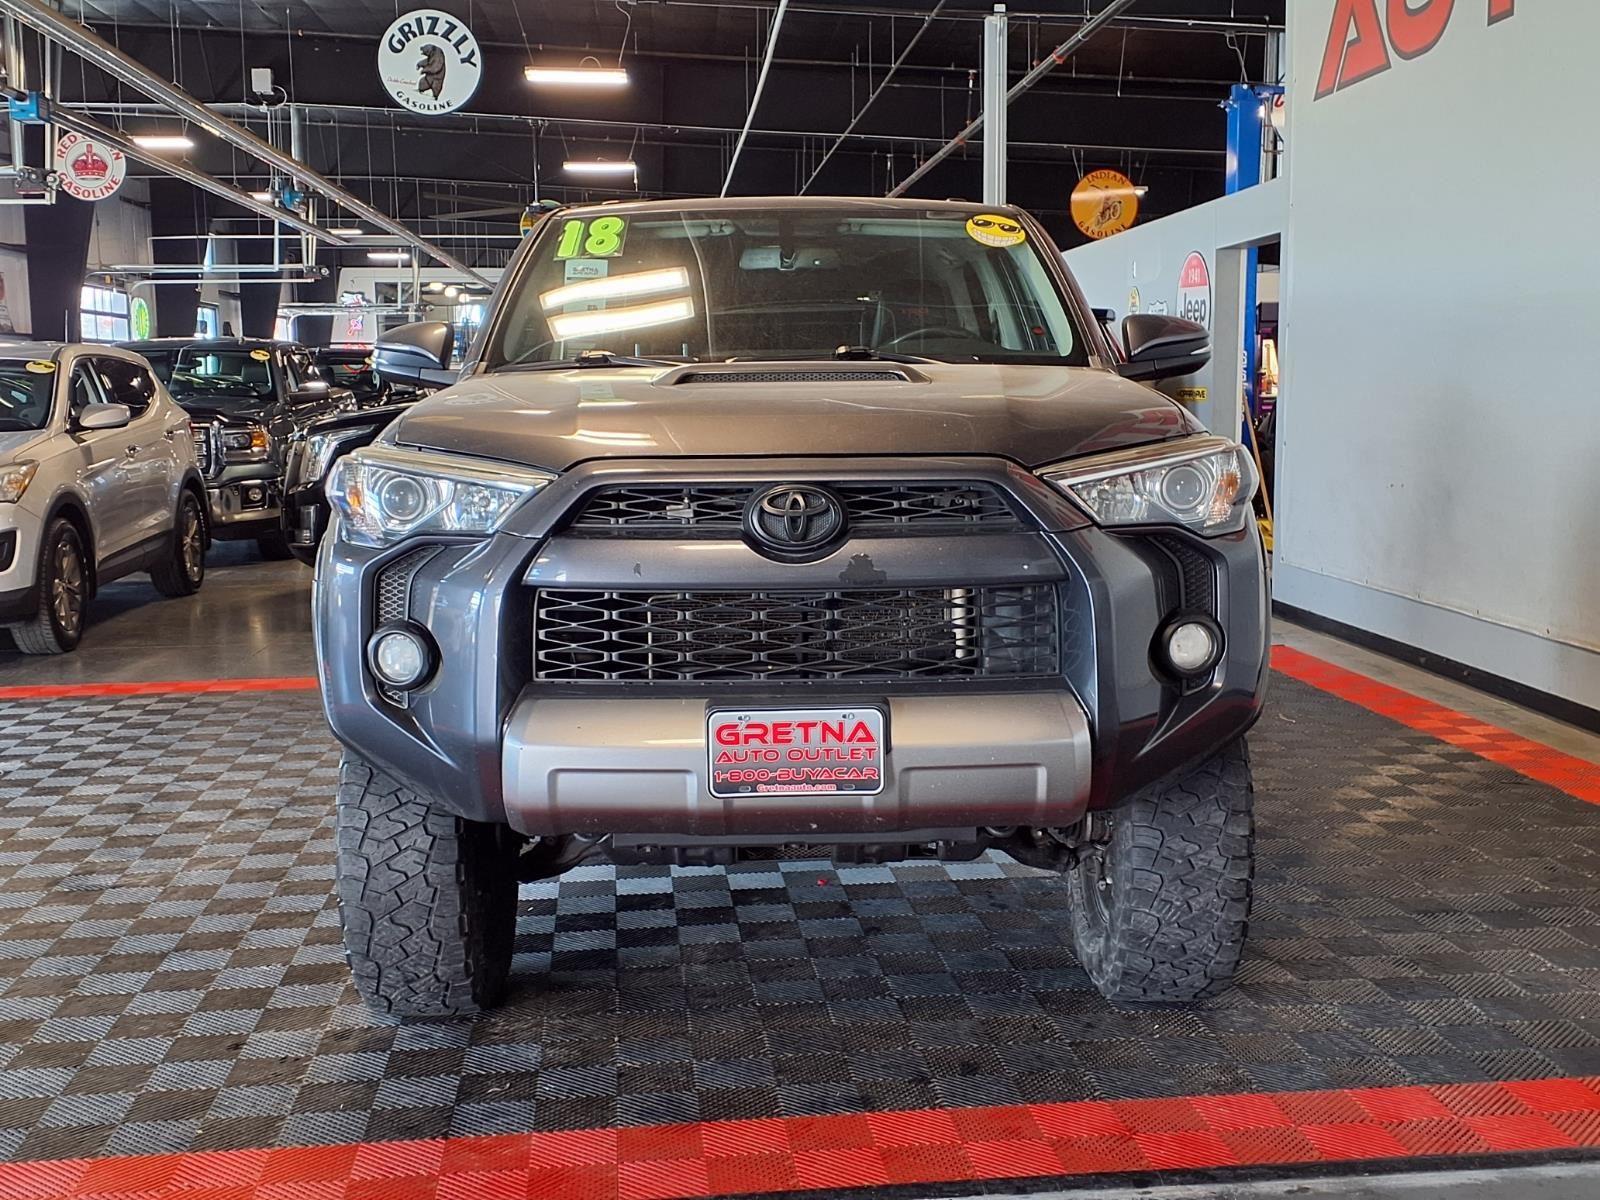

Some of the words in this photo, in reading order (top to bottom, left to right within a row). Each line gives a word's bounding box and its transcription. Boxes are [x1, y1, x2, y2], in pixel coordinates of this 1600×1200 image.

[388, 16, 477, 68] GRIZZLY
[396, 91, 453, 111] GASOLINE
[57, 134, 77, 159] RED
[1087, 171, 1126, 184] INDIAN
[557, 216, 625, 257] 18
[1180, 292, 1206, 323] Jeep
[715, 720, 877, 745] GRETNA
[715, 750, 779, 764] AUTO
[787, 747, 878, 762] OUTLET
[714, 767, 878, 782] 1-800-BUYACAR
